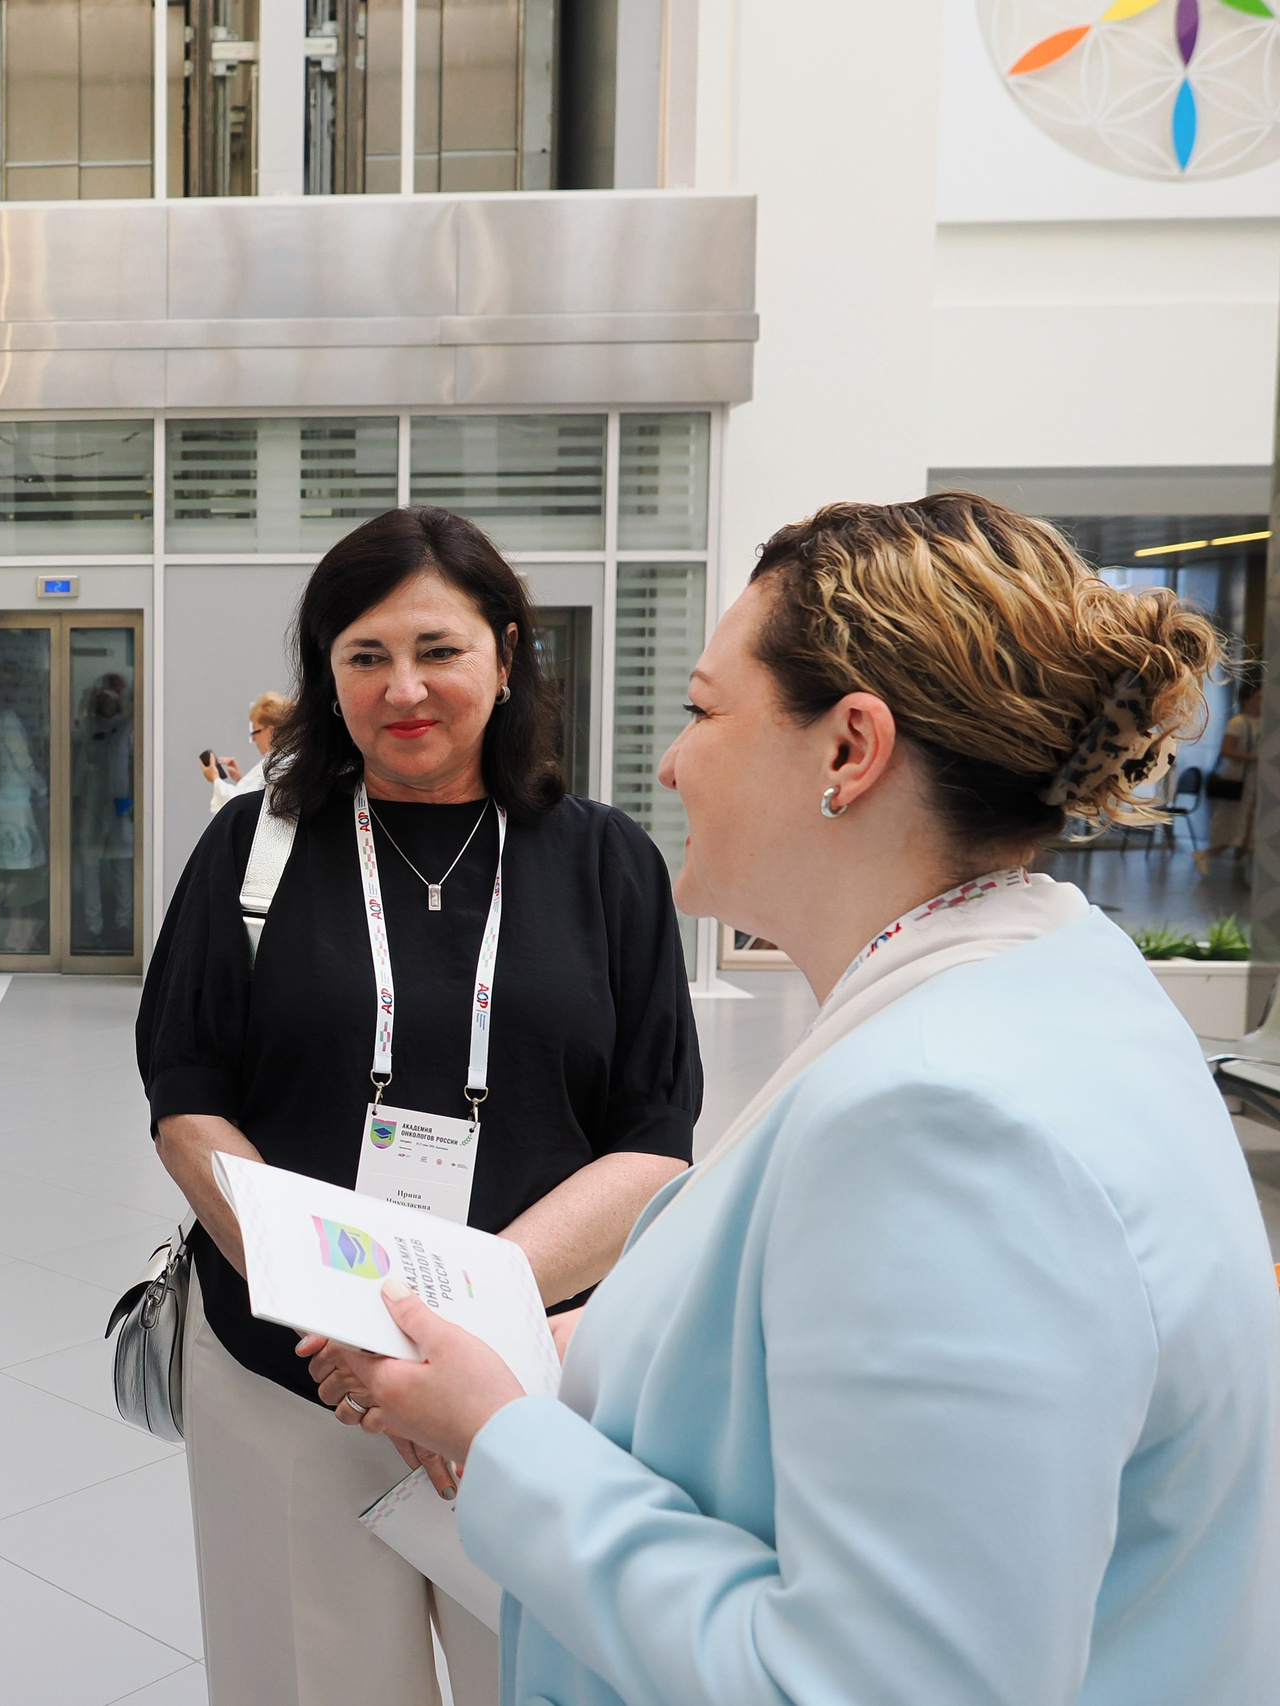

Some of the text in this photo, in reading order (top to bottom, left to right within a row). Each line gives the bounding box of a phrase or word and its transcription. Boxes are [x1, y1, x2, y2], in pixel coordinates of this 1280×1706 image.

[400, 1130, 458, 1146] ОНКОЛОГОВ РОССИИ
[402, 1123, 433, 1133] АКАДЕМИЯ
[397, 1189, 422, 1200] Ирина
[394, 1236, 420, 1296] КАДЕМИЯ
[410, 1238, 439, 1308] ОНКОЛОГОВ
[431, 1253, 454, 1301] РОССИИ
